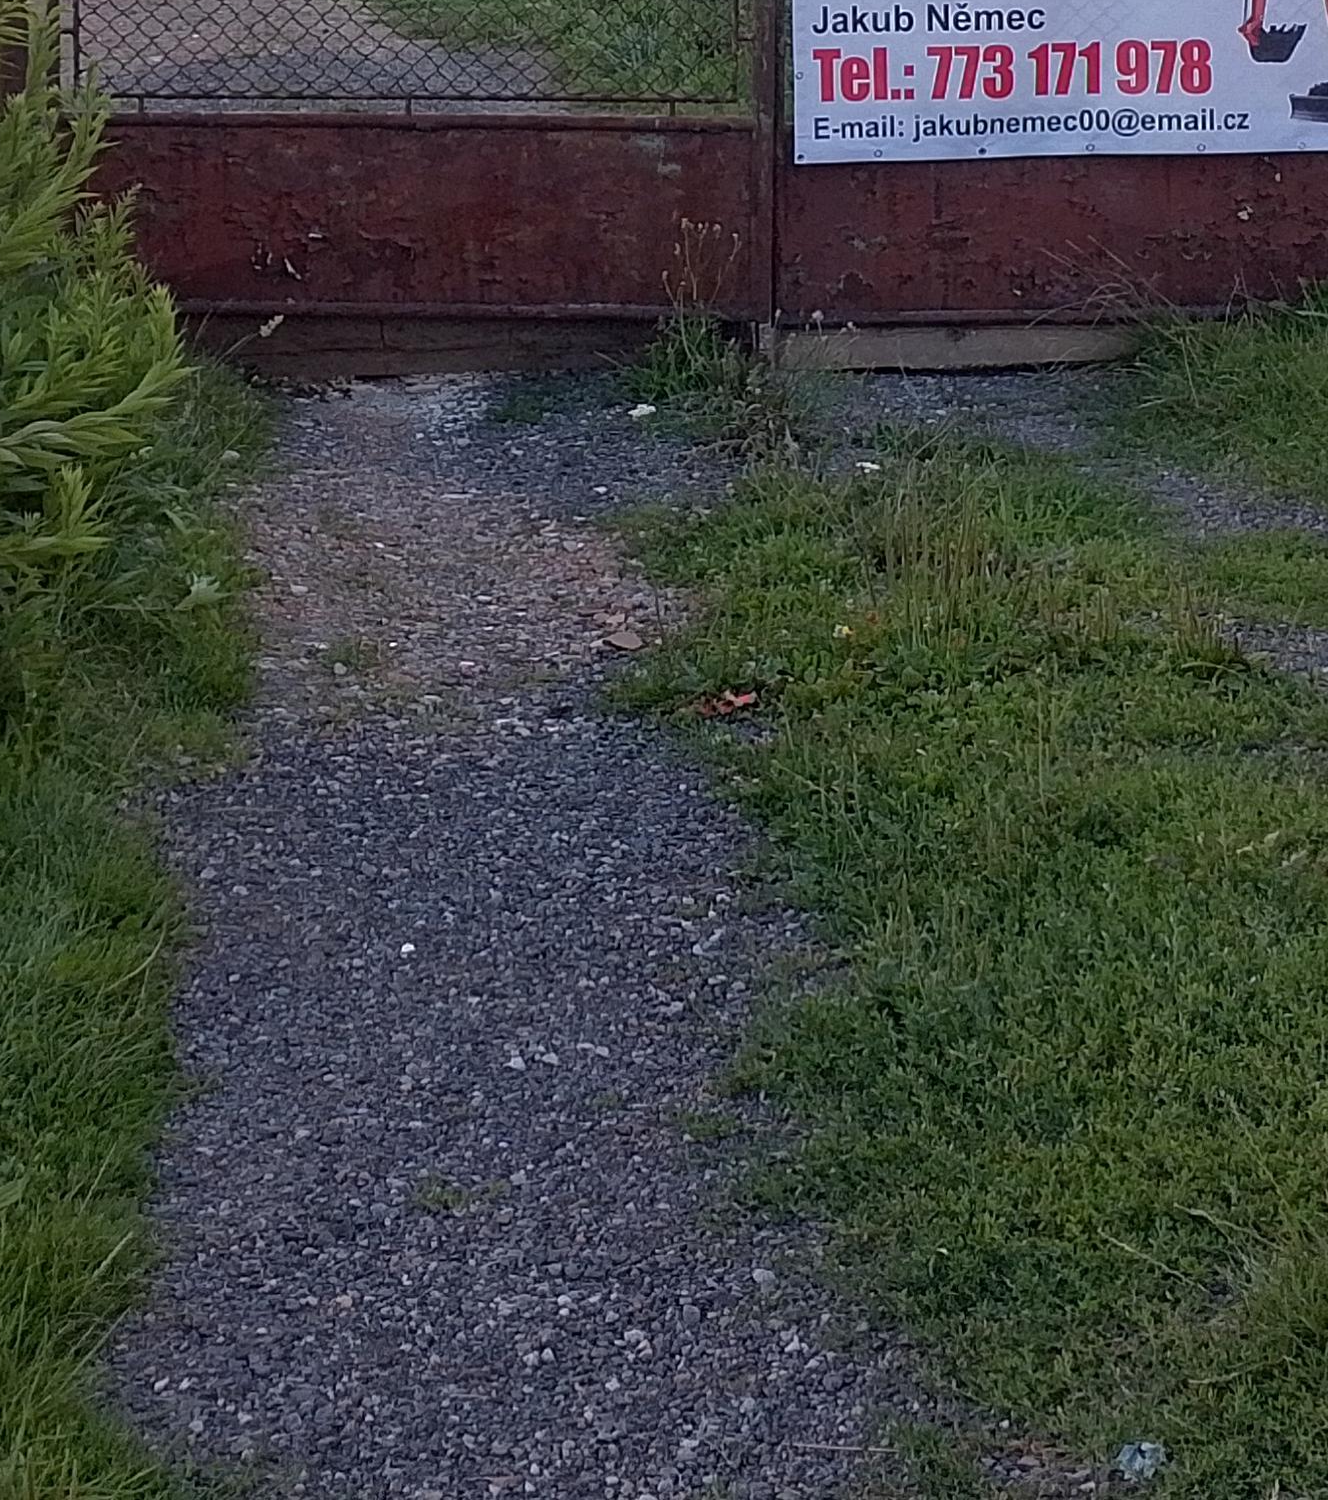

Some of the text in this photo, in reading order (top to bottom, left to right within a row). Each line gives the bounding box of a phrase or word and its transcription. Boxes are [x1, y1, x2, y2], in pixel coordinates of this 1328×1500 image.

[812, 2, 1046, 34] Jakub Němec
[812, 39, 1212, 102] Tel.: 773 171 978
[813, 108, 1250, 142] E-mail: jakubnemec00@email.cz
